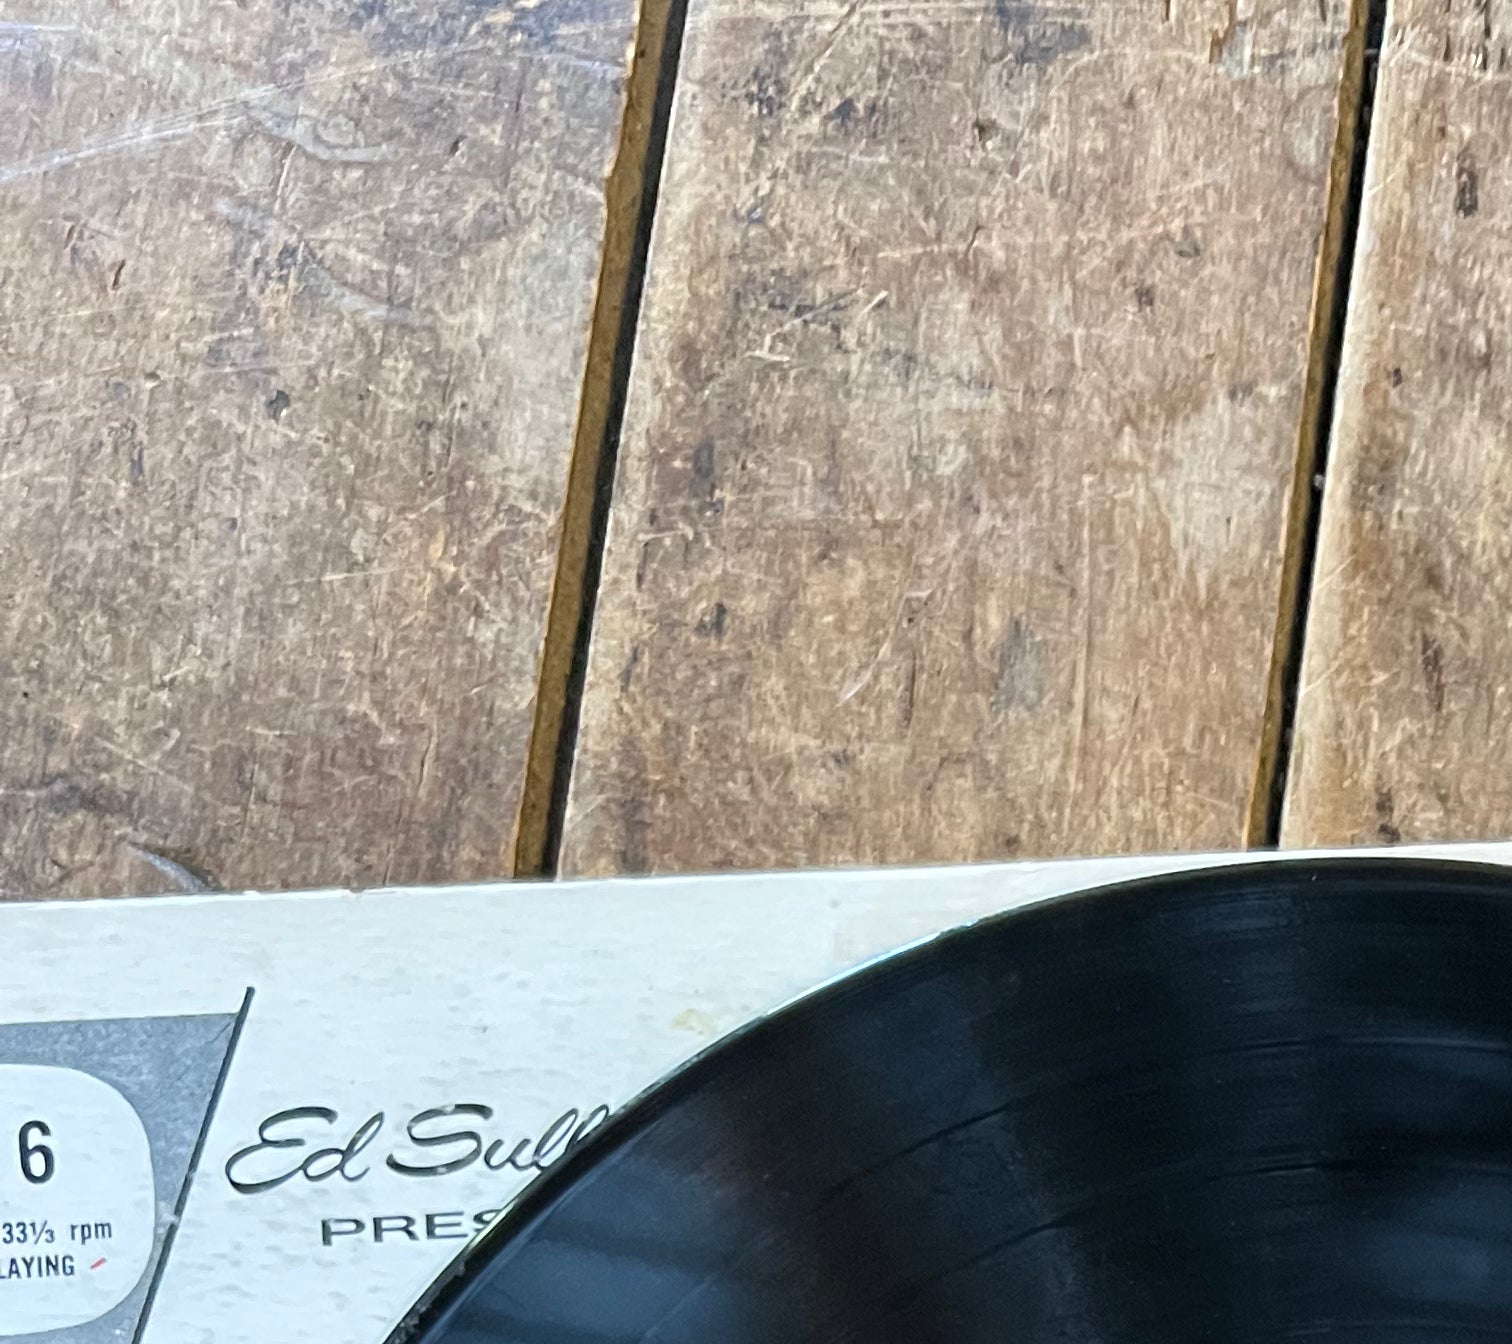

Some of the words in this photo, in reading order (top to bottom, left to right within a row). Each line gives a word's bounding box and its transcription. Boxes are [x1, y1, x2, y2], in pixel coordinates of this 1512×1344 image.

[18, 1120, 55, 1184] 6
[225, 1106, 385, 1195] Ed
[70, 1221, 113, 1245] rpm
